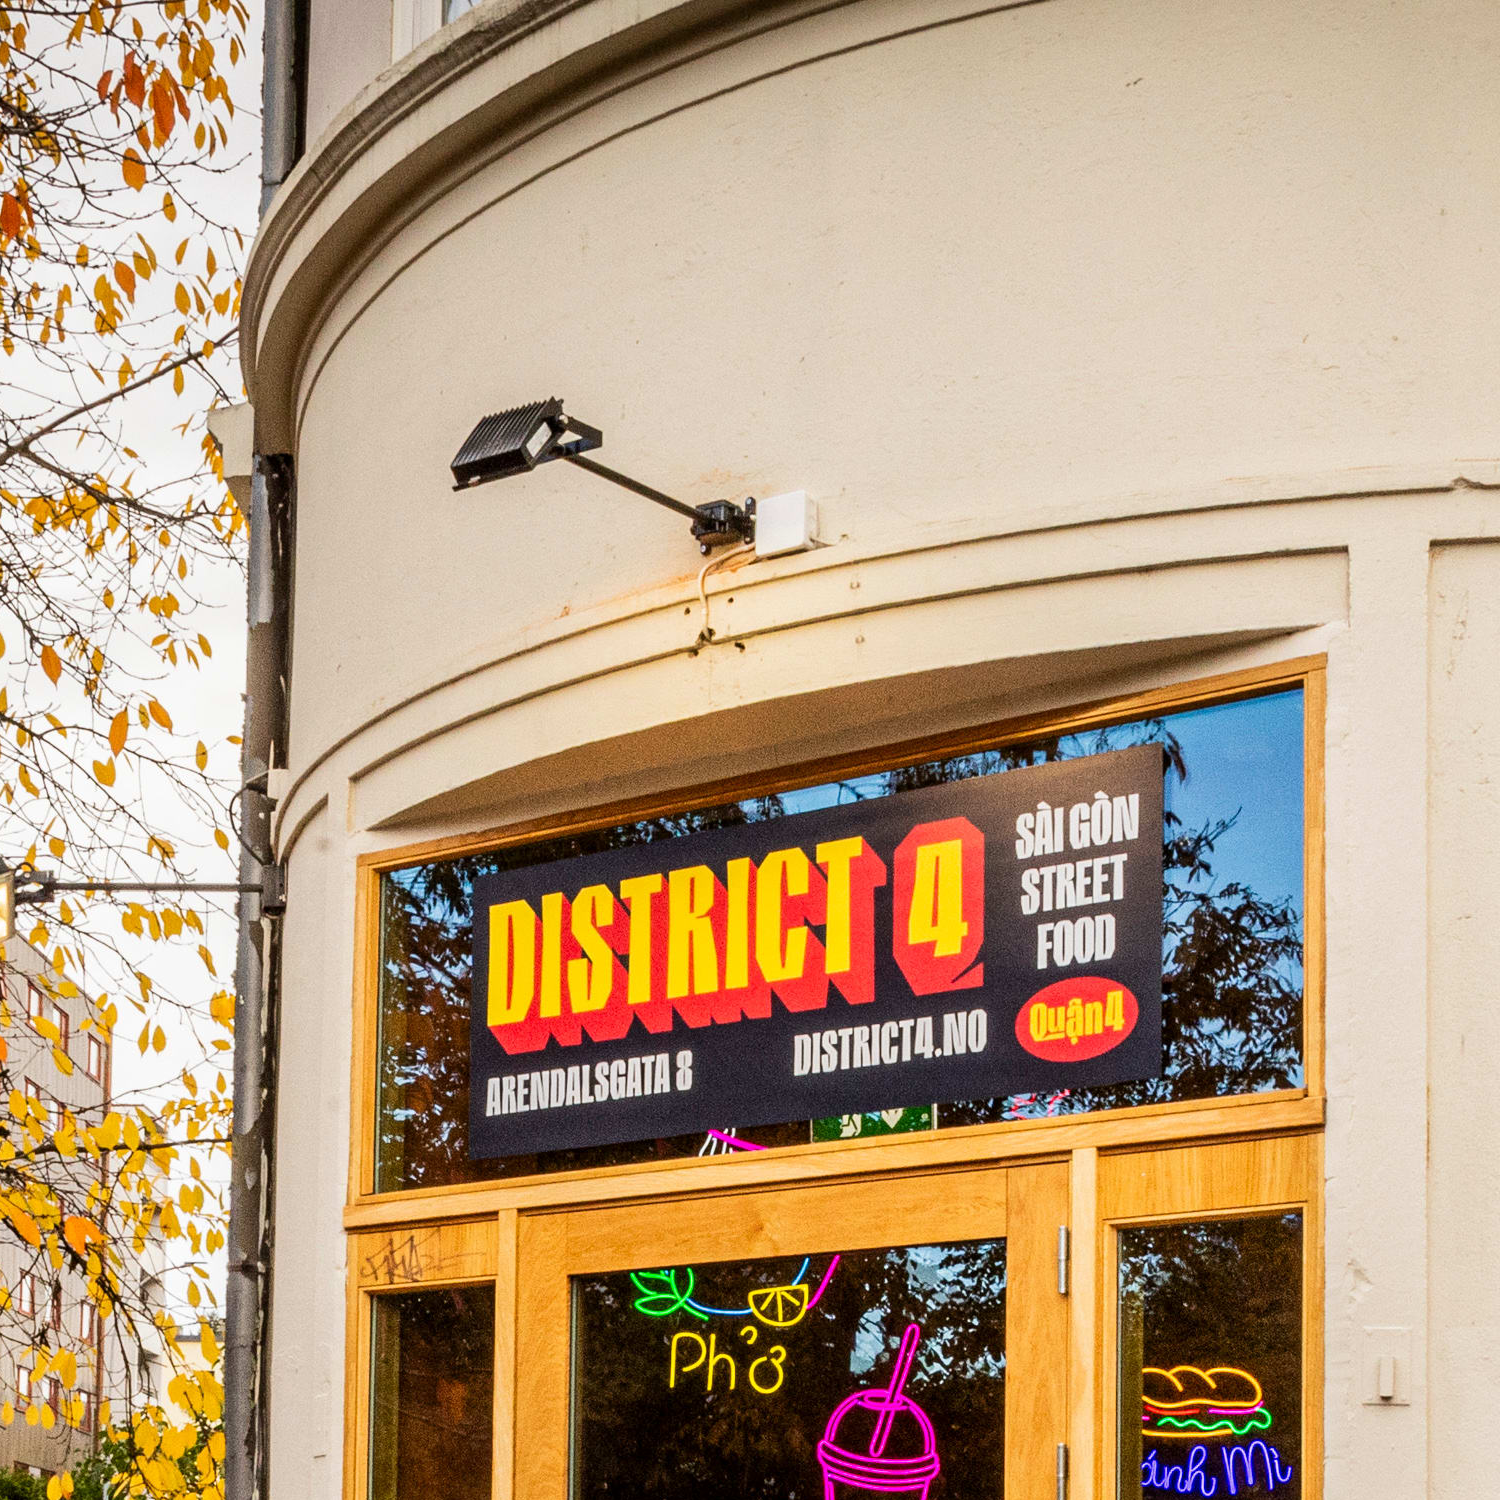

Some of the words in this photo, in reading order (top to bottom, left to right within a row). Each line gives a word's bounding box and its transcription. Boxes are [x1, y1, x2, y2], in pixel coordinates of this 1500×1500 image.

[1015, 800, 1065, 860] SÀI
[1020, 853, 1128, 915] STREET
[487, 836, 880, 1045] DISTRICT
[904, 834, 972, 961] 4
[1037, 913, 1116, 970] FOOD
[794, 1008, 988, 1077] DISTRICT4.NO
[486, 1052, 671, 1117] ARENDALSGATA
[676, 1050, 693, 1092] 8
[1140, 1444, 1217, 1498] ánh
